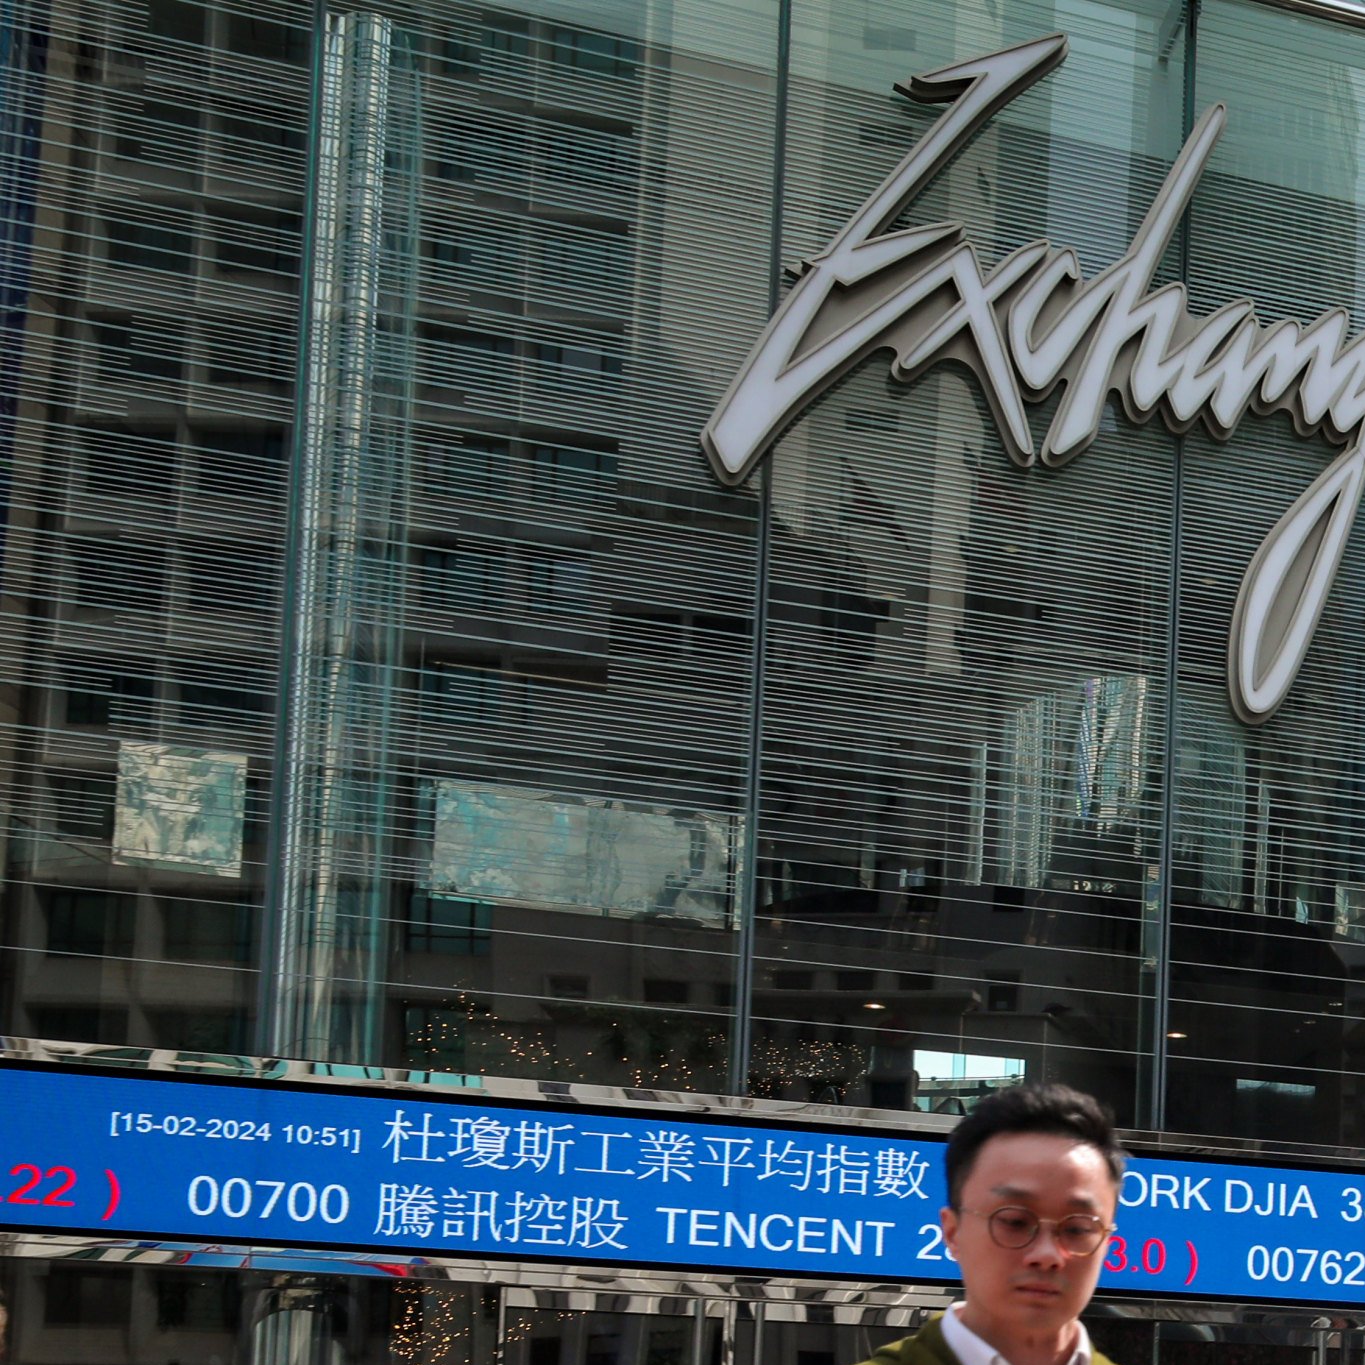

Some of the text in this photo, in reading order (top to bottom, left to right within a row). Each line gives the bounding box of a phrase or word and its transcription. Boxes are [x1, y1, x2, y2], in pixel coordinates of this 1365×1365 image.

[111, 1112, 360, 1153] [15-02-2024 10:51]
[382, 1109, 930, 1199] 杜瓊斯工業平均指數
[189, 1176, 349, 1223] 00700
[374, 1184, 628, 1249] 騰訊控股
[1225, 1180, 1317, 1218] DJIA
[656, 1208, 959, 1262] TENCENT 2
[1248, 1246, 1365, 1285] 00762
